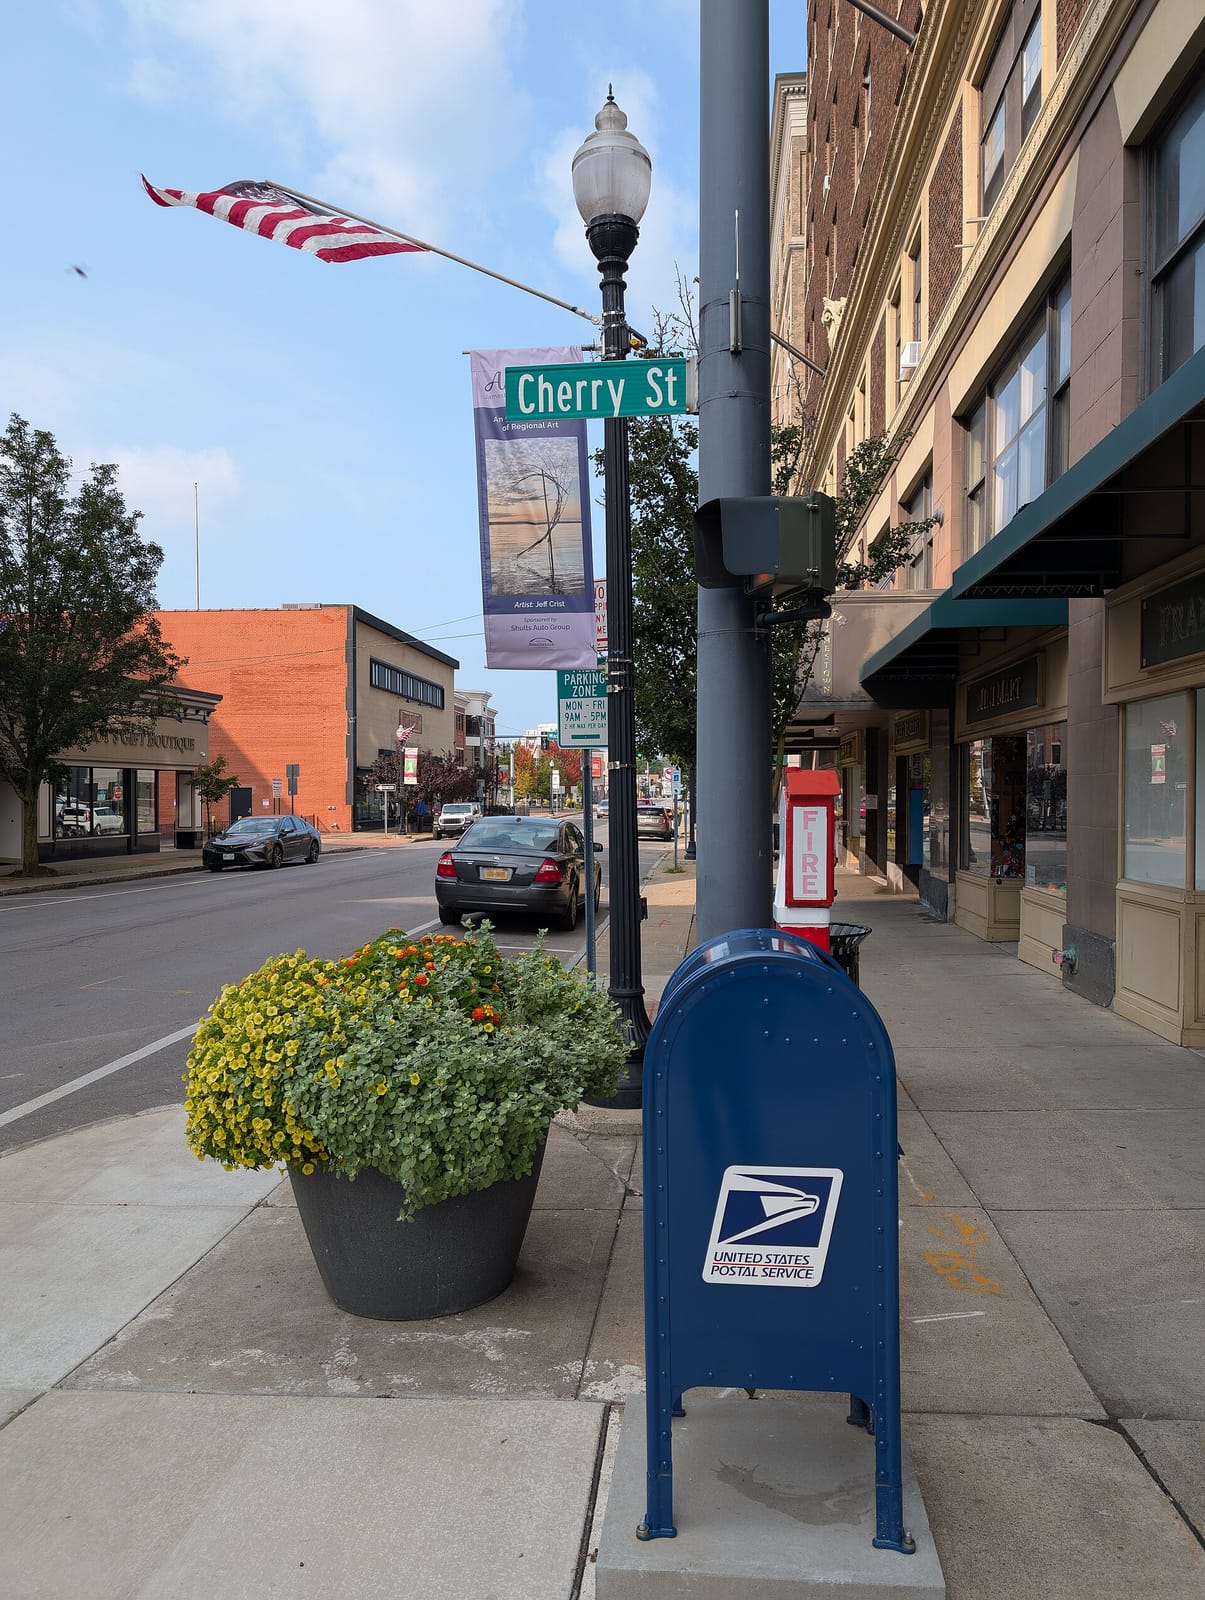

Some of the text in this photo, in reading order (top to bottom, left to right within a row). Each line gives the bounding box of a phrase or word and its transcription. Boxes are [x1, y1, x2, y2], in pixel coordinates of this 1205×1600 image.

[518, 373, 625, 417] Cherry
[645, 367, 678, 408] St
[502, 421, 559, 431] of Regional Art
[535, 600, 548, 608] Jeff
[549, 600, 565, 608] Crist
[595, 614, 606, 622] NY
[511, 624, 532, 632] Shults
[550, 624, 570, 632] Group
[564, 672, 605, 686] PARKING
[572, 684, 598, 697] ZONE
[565, 700, 583, 711] MON
[592, 700, 605, 710] FRI
[564, 712, 581, 722] 9AM
[590, 711, 607, 721] 5PM
[147, 734, 195, 754] BOUTIQUE
[801, 810, 819, 895] FIRE
[713, 1251, 811, 1266] UNITED STATES
[711, 1265, 815, 1280] POSTAL SERVICE
